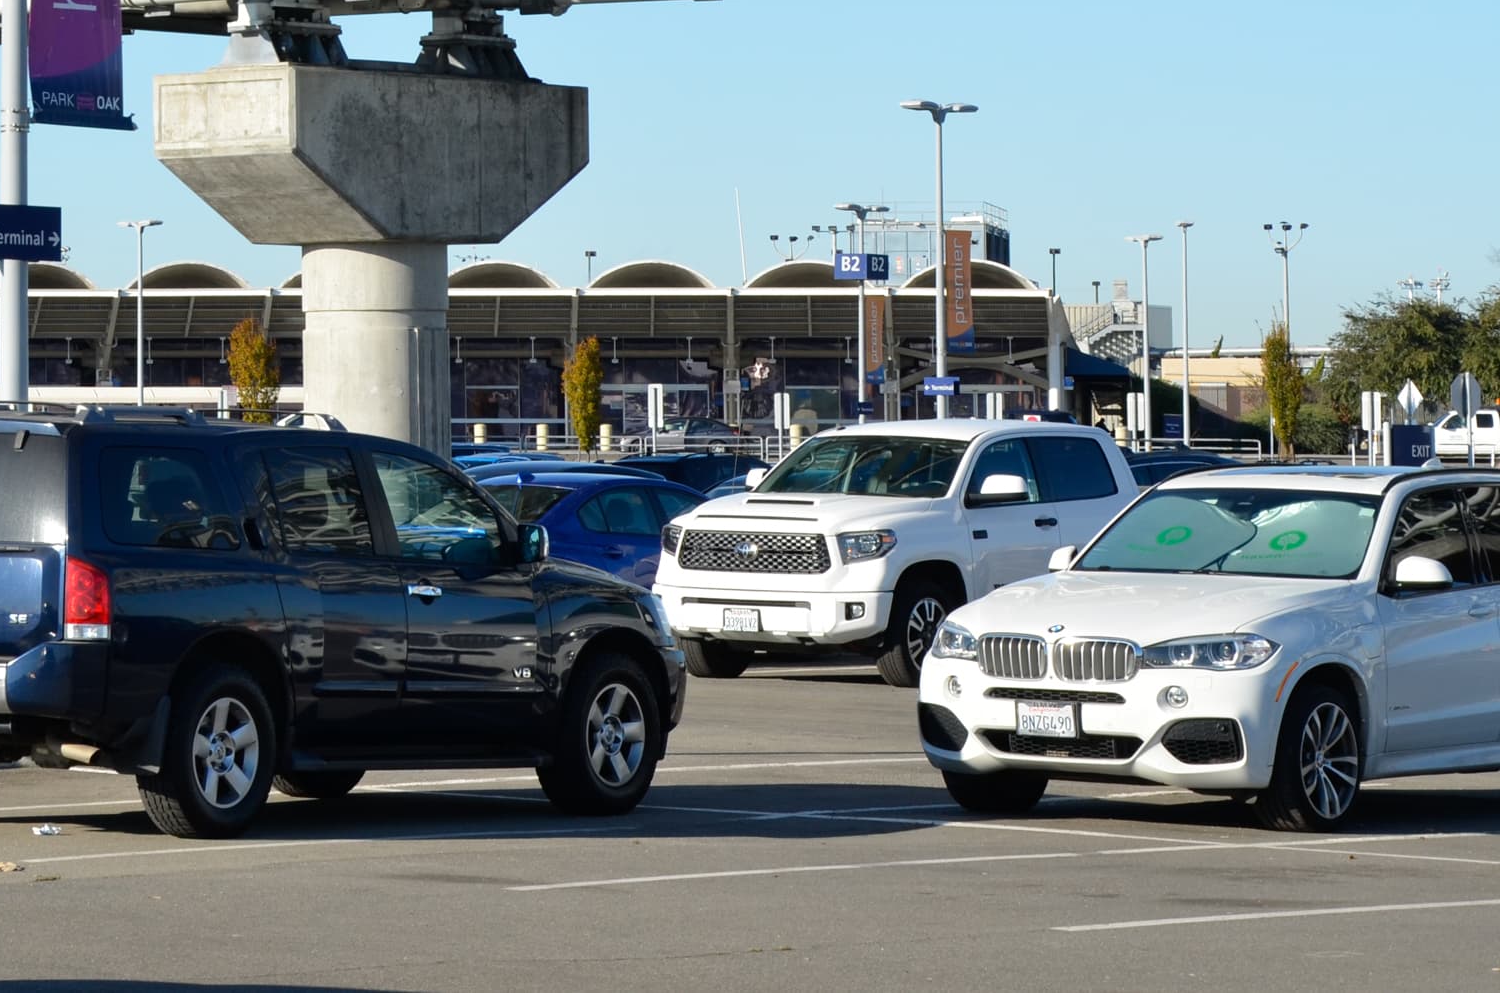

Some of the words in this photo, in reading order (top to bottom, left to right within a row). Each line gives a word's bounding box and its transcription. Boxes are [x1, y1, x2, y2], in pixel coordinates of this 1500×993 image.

[41, 91, 75, 107] PARK
[96, 95, 120, 111] OAK
[840, 256, 861, 272] B2
[871, 256, 885, 273] B2
[955, 237, 968, 325] premier
[1411, 444, 1431, 458] EXIT
[8, 613, 29, 624] SE
[513, 667, 532, 679] V8
[1021, 714, 1073, 732] 8NZG490
